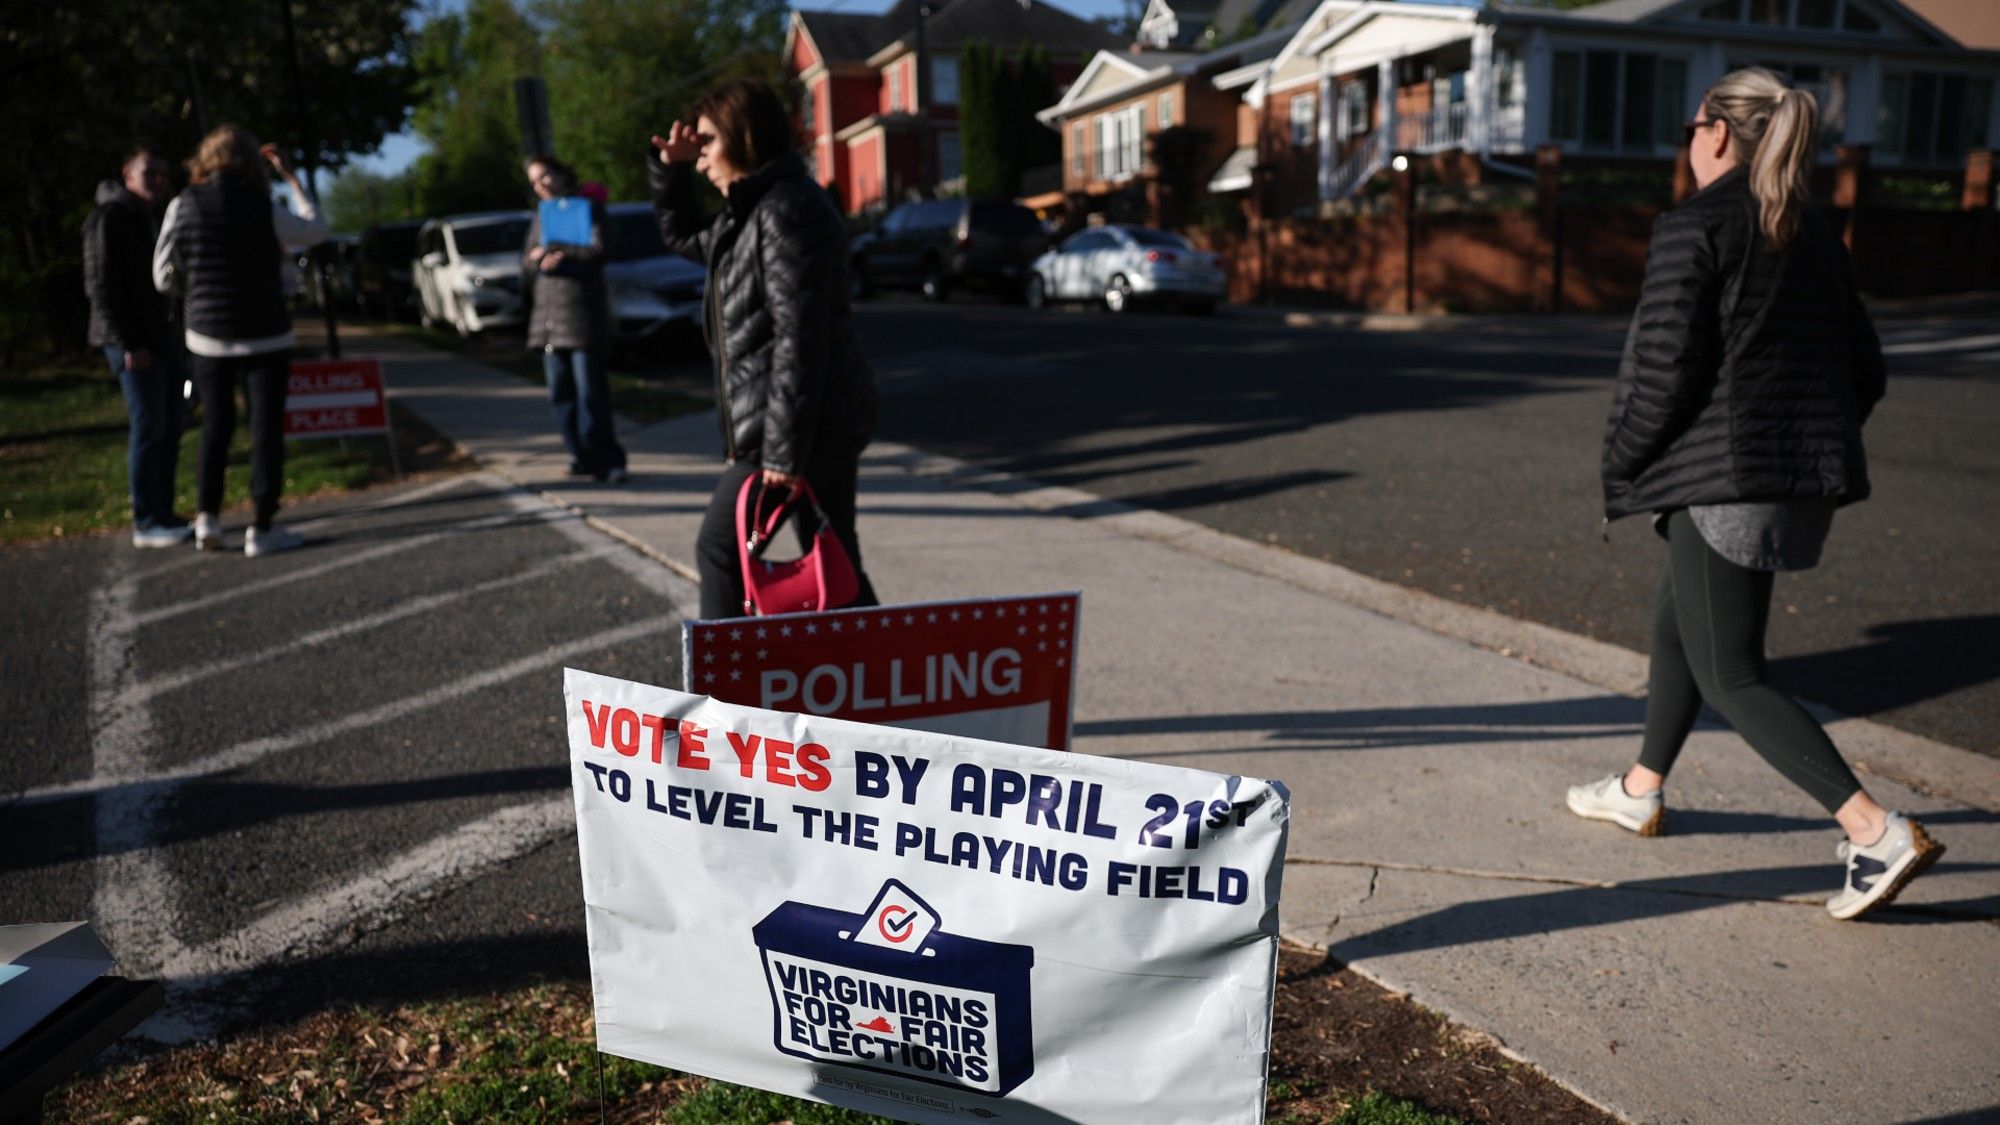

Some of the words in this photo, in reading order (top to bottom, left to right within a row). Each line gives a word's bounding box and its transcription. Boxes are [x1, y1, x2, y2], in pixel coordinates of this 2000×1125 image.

[287, 372, 364, 390] OLLING
[290, 408, 359, 429] PLACE
[760, 647, 1022, 714] POLLING
[582, 699, 709, 771] VOTE
[726, 730, 832, 791] YES
[855, 751, 929, 806] BY
[950, 763, 1117, 841] APRIL
[1138, 792, 1257, 851] 21ST
[584, 760, 631, 804] TO
[646, 778, 778, 833] LEVEL
[793, 804, 878, 852] THE
[895, 822, 1088, 892] PLAYING
[1107, 861, 1249, 906] FIELD
[773, 960, 989, 1028] VIRGINIANS
[783, 990, 854, 1031] FOR
[900, 1015, 988, 1058] FAIR
[790, 1014, 990, 1083] ELECTIONS
